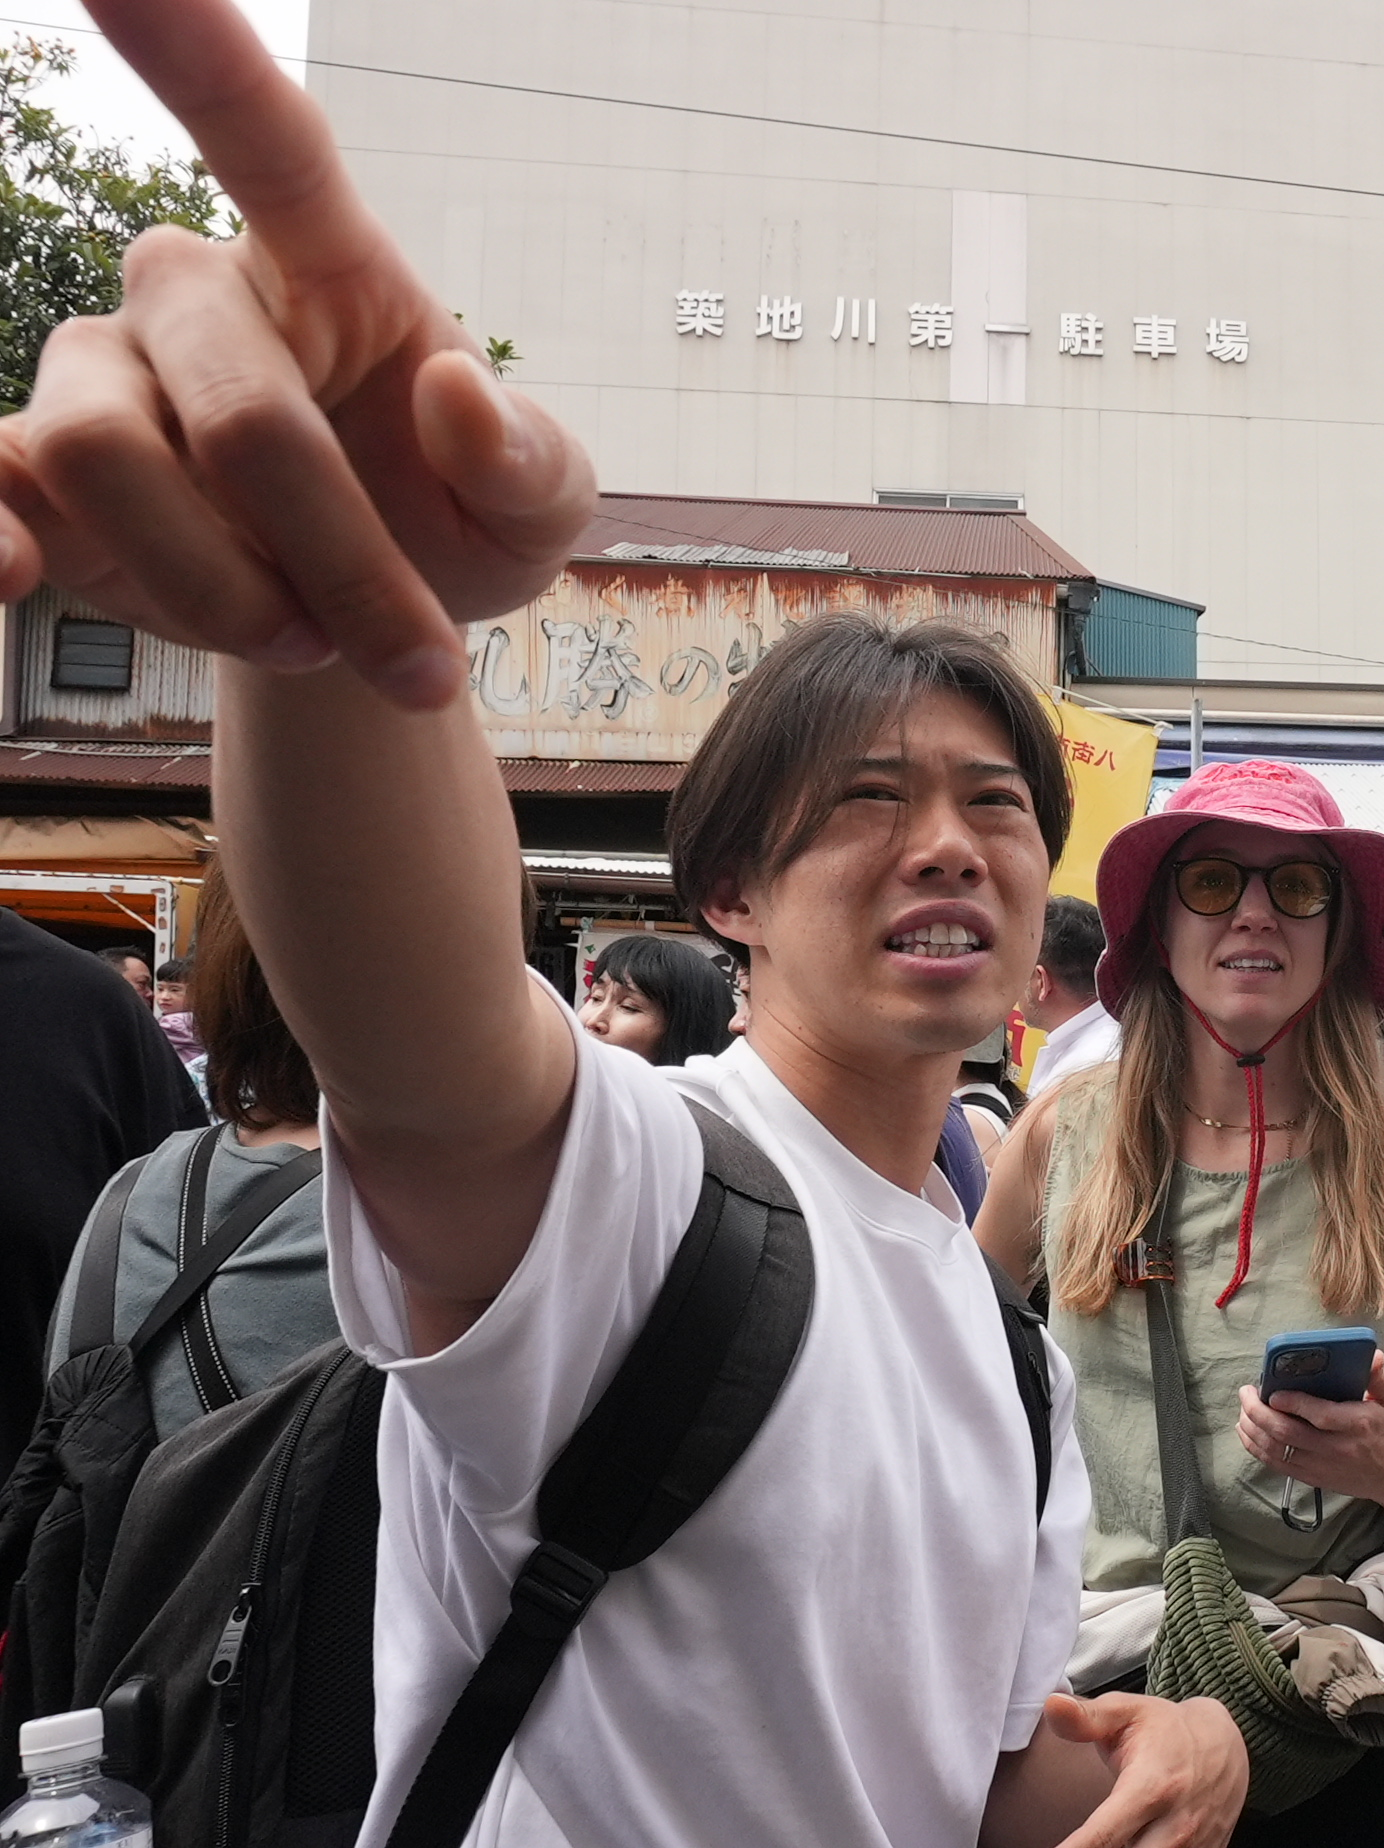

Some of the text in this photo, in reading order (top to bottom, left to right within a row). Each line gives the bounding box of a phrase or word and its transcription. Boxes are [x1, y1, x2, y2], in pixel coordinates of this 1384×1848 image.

[674, 288, 1250, 363] 築地川第一駐車場
